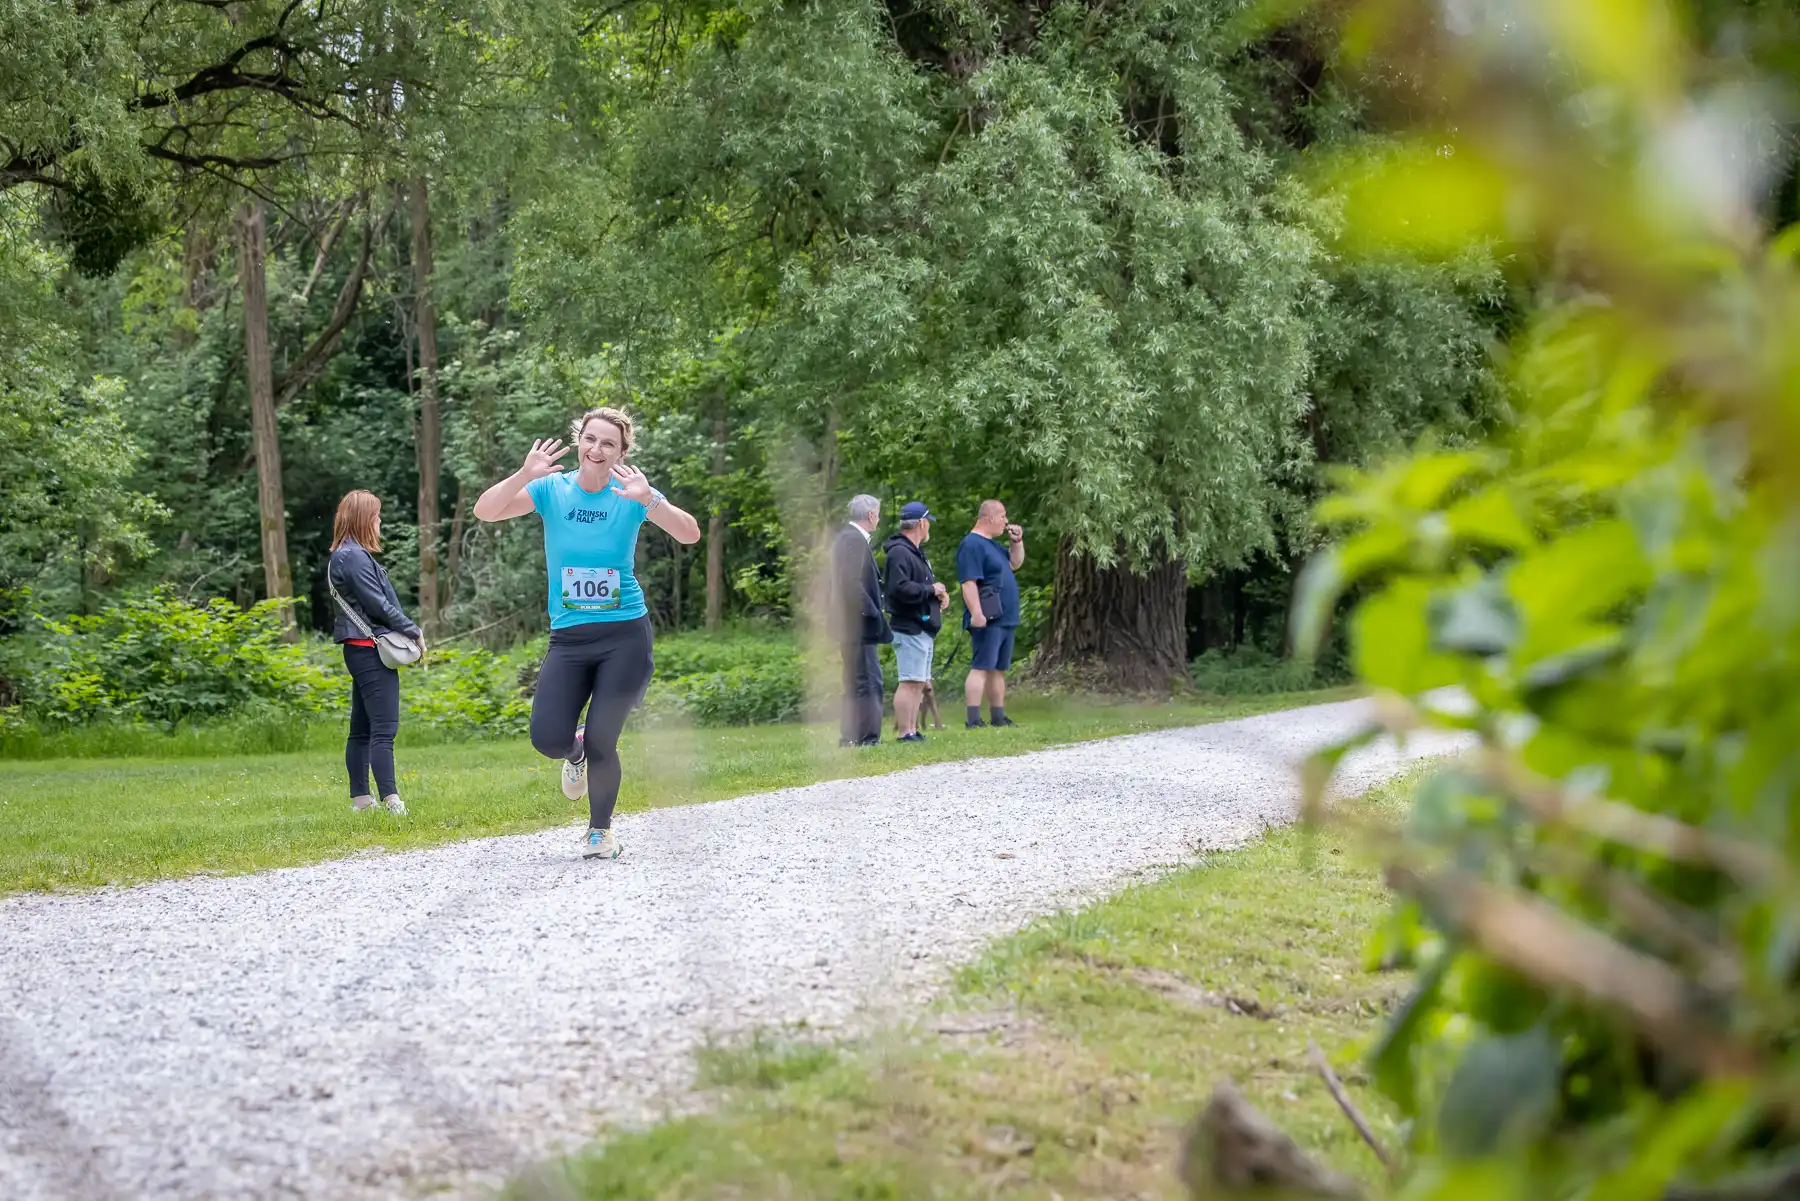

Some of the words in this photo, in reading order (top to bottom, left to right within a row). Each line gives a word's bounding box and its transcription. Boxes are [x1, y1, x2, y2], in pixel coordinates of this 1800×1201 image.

[577, 509, 607, 518] ZRINSKI
[576, 516, 595, 524] HALF
[573, 580, 609, 597] 106
